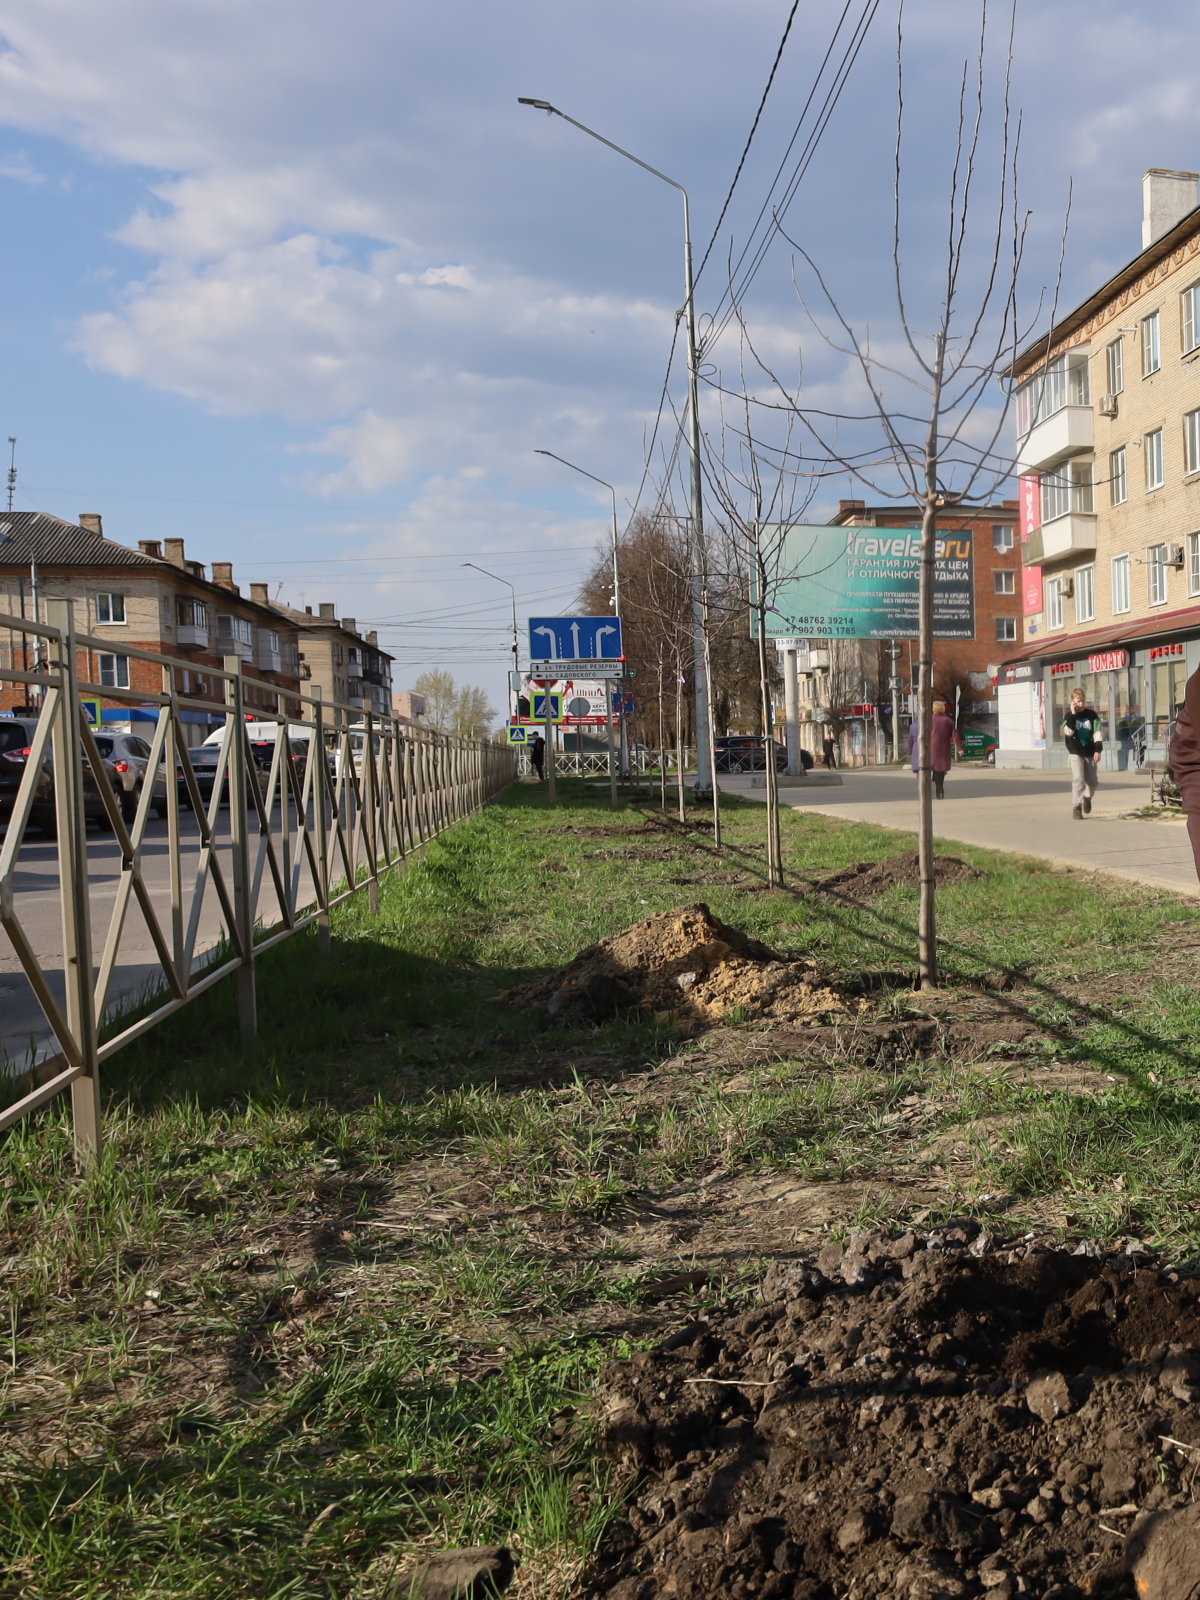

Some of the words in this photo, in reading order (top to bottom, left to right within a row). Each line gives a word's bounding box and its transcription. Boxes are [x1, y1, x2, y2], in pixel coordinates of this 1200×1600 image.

[847, 558, 900, 568] ГАРАНТИЯ
[948, 560, 969, 571] ЦЕН
[847, 569, 855, 578] И
[934, 571, 969, 581] ТДЫХА
[798, 616, 825, 624] 48762
[828, 617, 854, 625] 39214
[785, 626, 795, 635] +7
[799, 627, 814, 635] 902
[817, 627, 833, 635] 903
[836, 627, 856, 635] 1785
[1088, 650, 1127, 672] TOMATO
